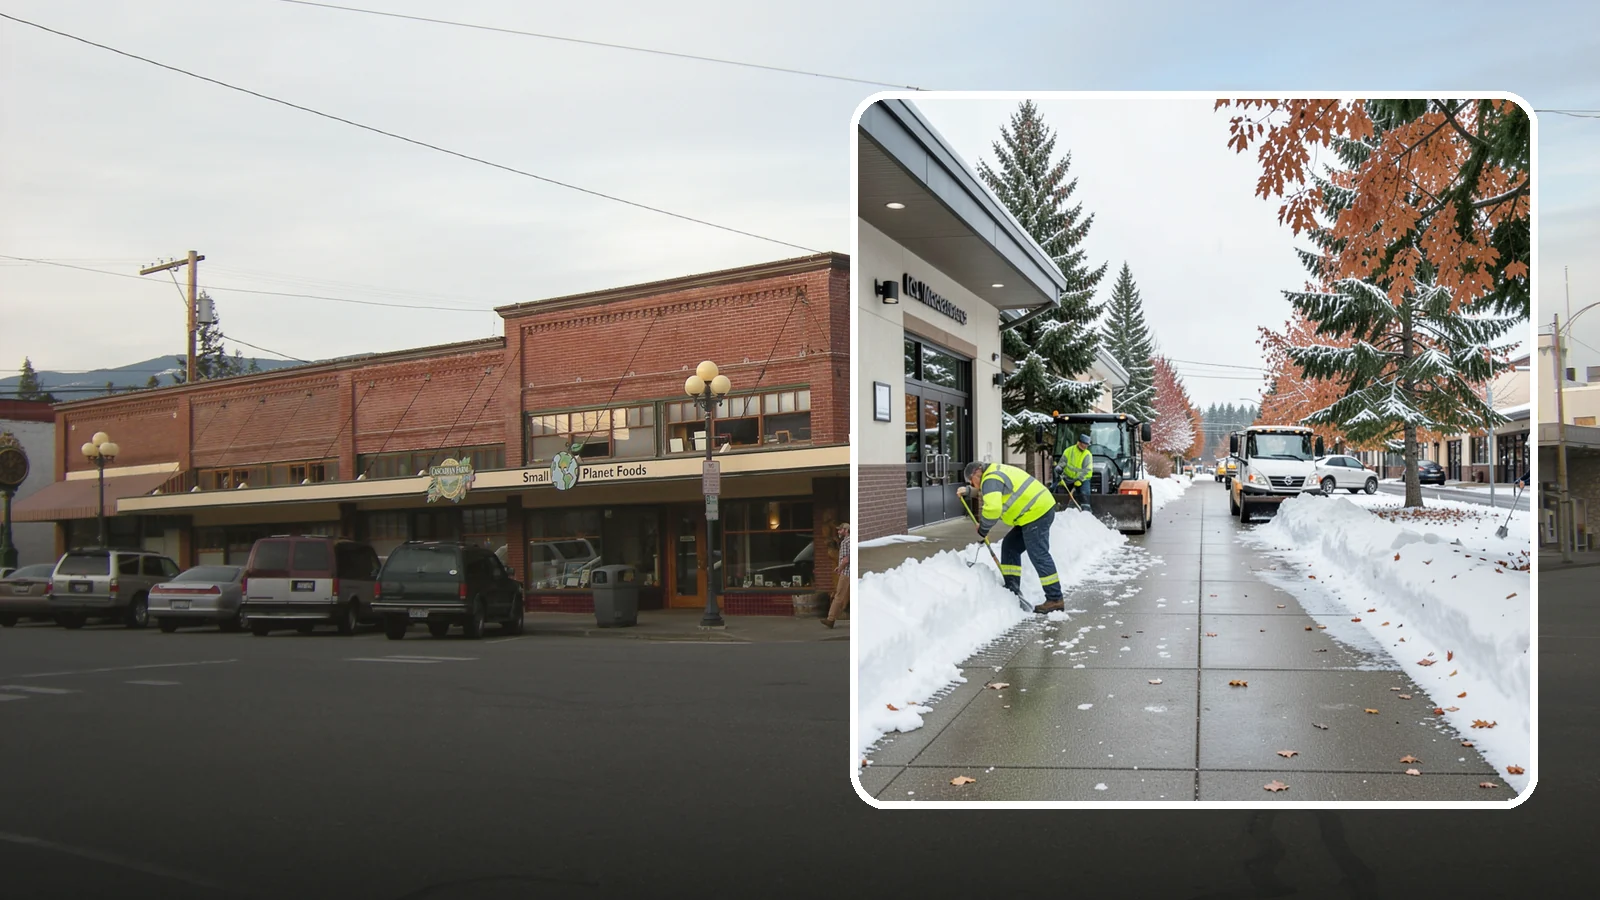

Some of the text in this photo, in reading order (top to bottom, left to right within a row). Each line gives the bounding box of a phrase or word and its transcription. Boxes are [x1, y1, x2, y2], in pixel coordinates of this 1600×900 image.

[431, 467, 455, 476] CASCADIAN
[523, 464, 647, 483] Small Planet Foods
